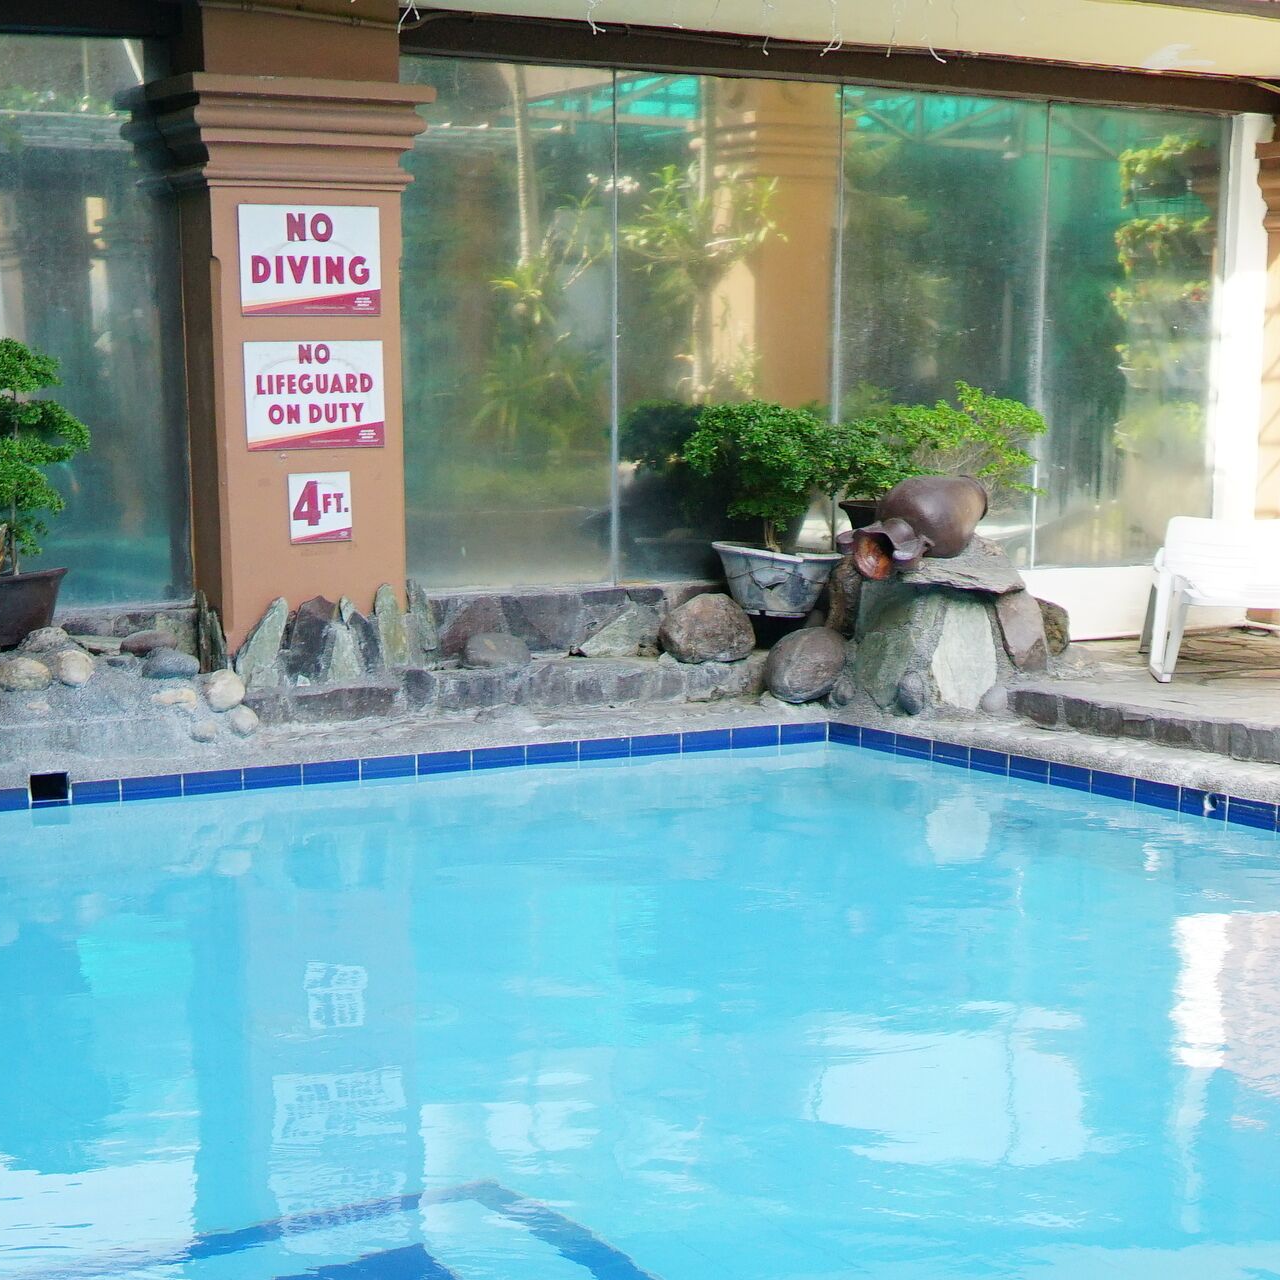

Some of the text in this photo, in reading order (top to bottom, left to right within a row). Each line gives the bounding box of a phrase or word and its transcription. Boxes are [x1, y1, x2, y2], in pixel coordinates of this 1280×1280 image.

[286, 212, 334, 243] NO
[251, 254, 370, 286] DIVING
[298, 343, 331, 365] NO
[256, 372, 374, 396] LIFEGUARD
[268, 402, 364, 425] ON DUTY
